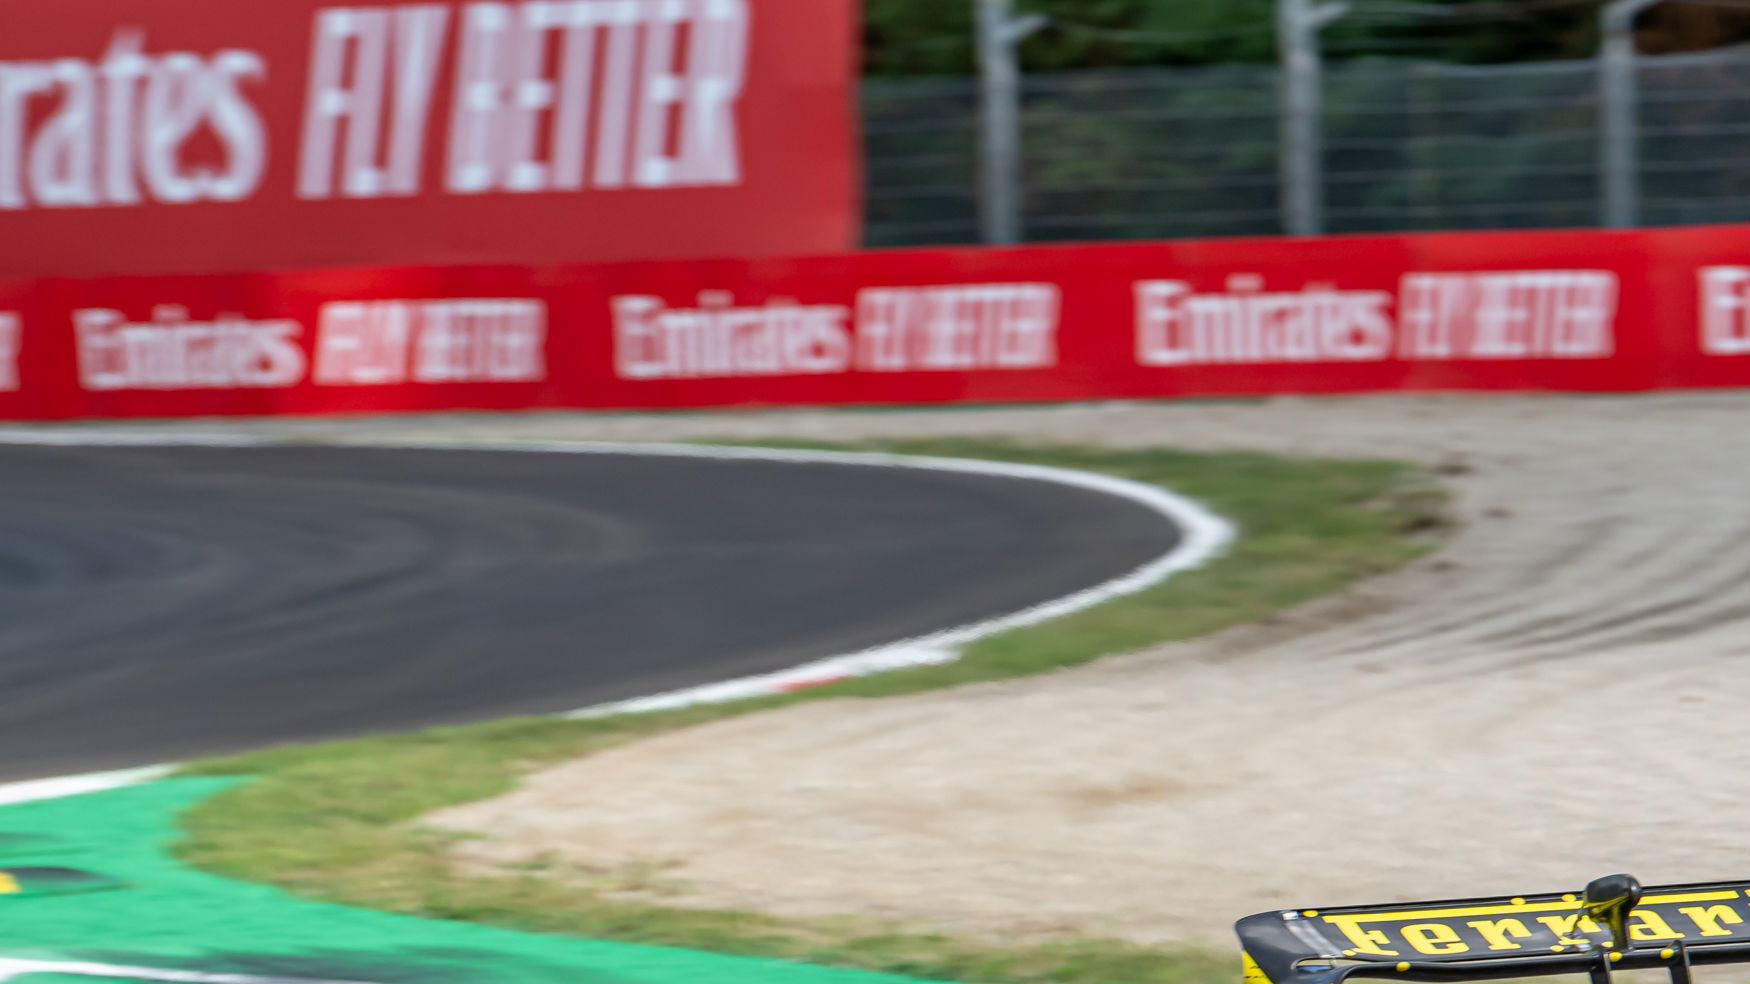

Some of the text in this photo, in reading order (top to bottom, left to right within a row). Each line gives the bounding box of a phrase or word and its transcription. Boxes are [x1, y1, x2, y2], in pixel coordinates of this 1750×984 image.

[297, 6, 450, 197] FLY
[444, 0, 751, 193] BETTER
[73, 304, 305, 390] Emirates
[610, 290, 852, 380] Emirates
[1132, 273, 1398, 367] Emirates
